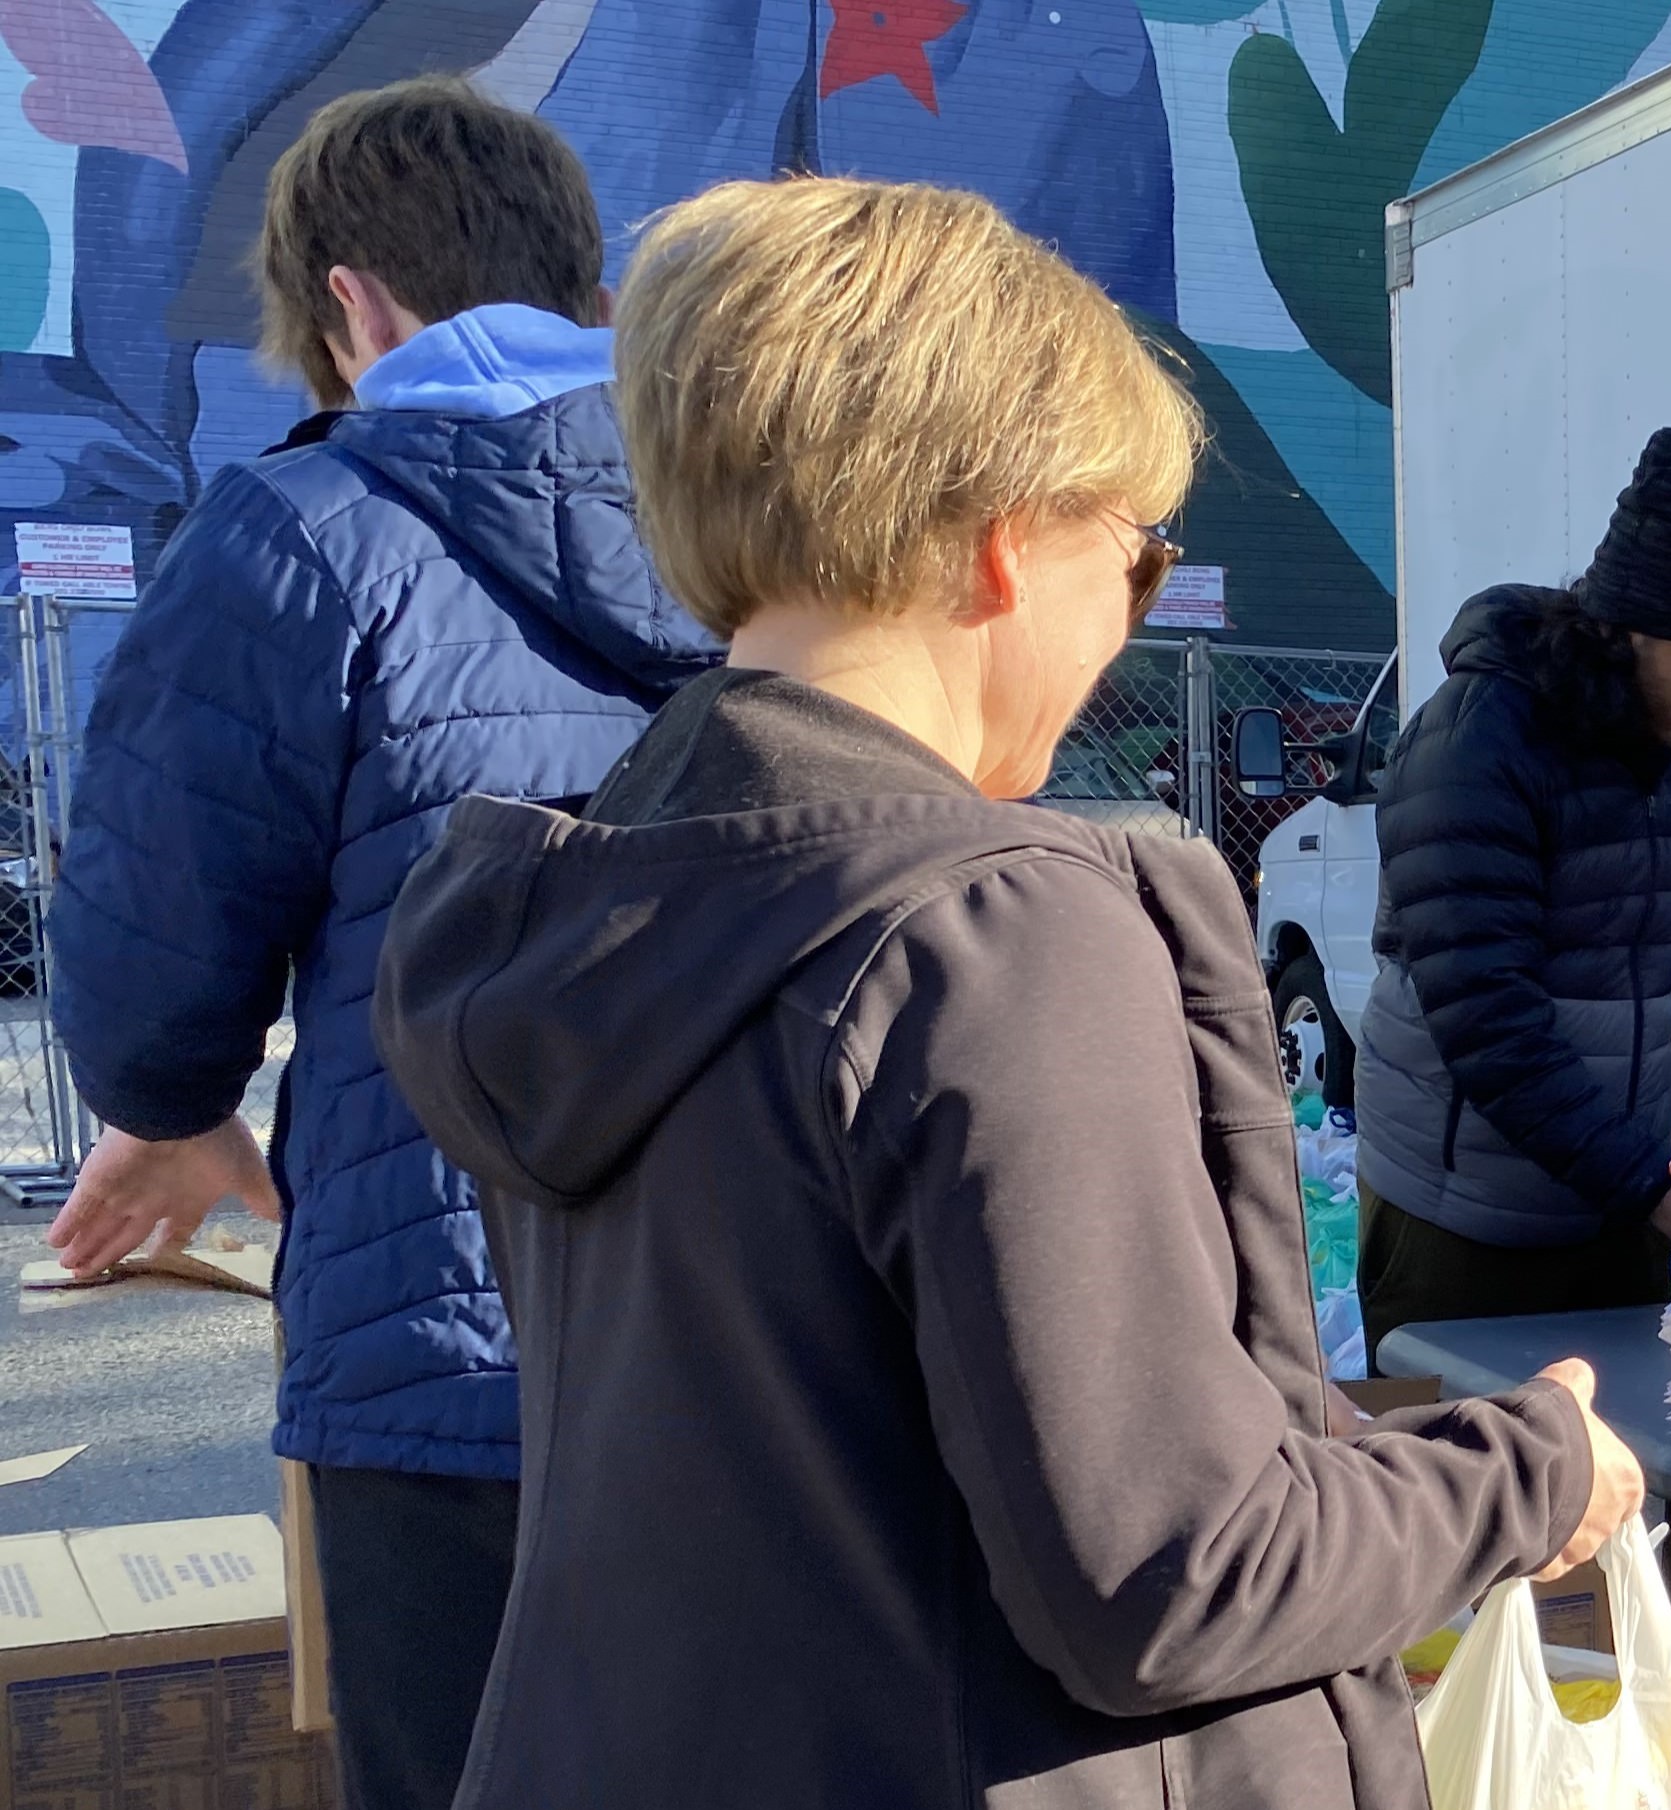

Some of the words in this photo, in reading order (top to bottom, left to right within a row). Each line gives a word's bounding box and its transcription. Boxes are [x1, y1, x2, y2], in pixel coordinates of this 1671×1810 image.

[19, 534, 70, 542] CUSTOMER
[81, 535, 129, 544] EMPLOYEE
[42, 543, 83, 551] PARKING
